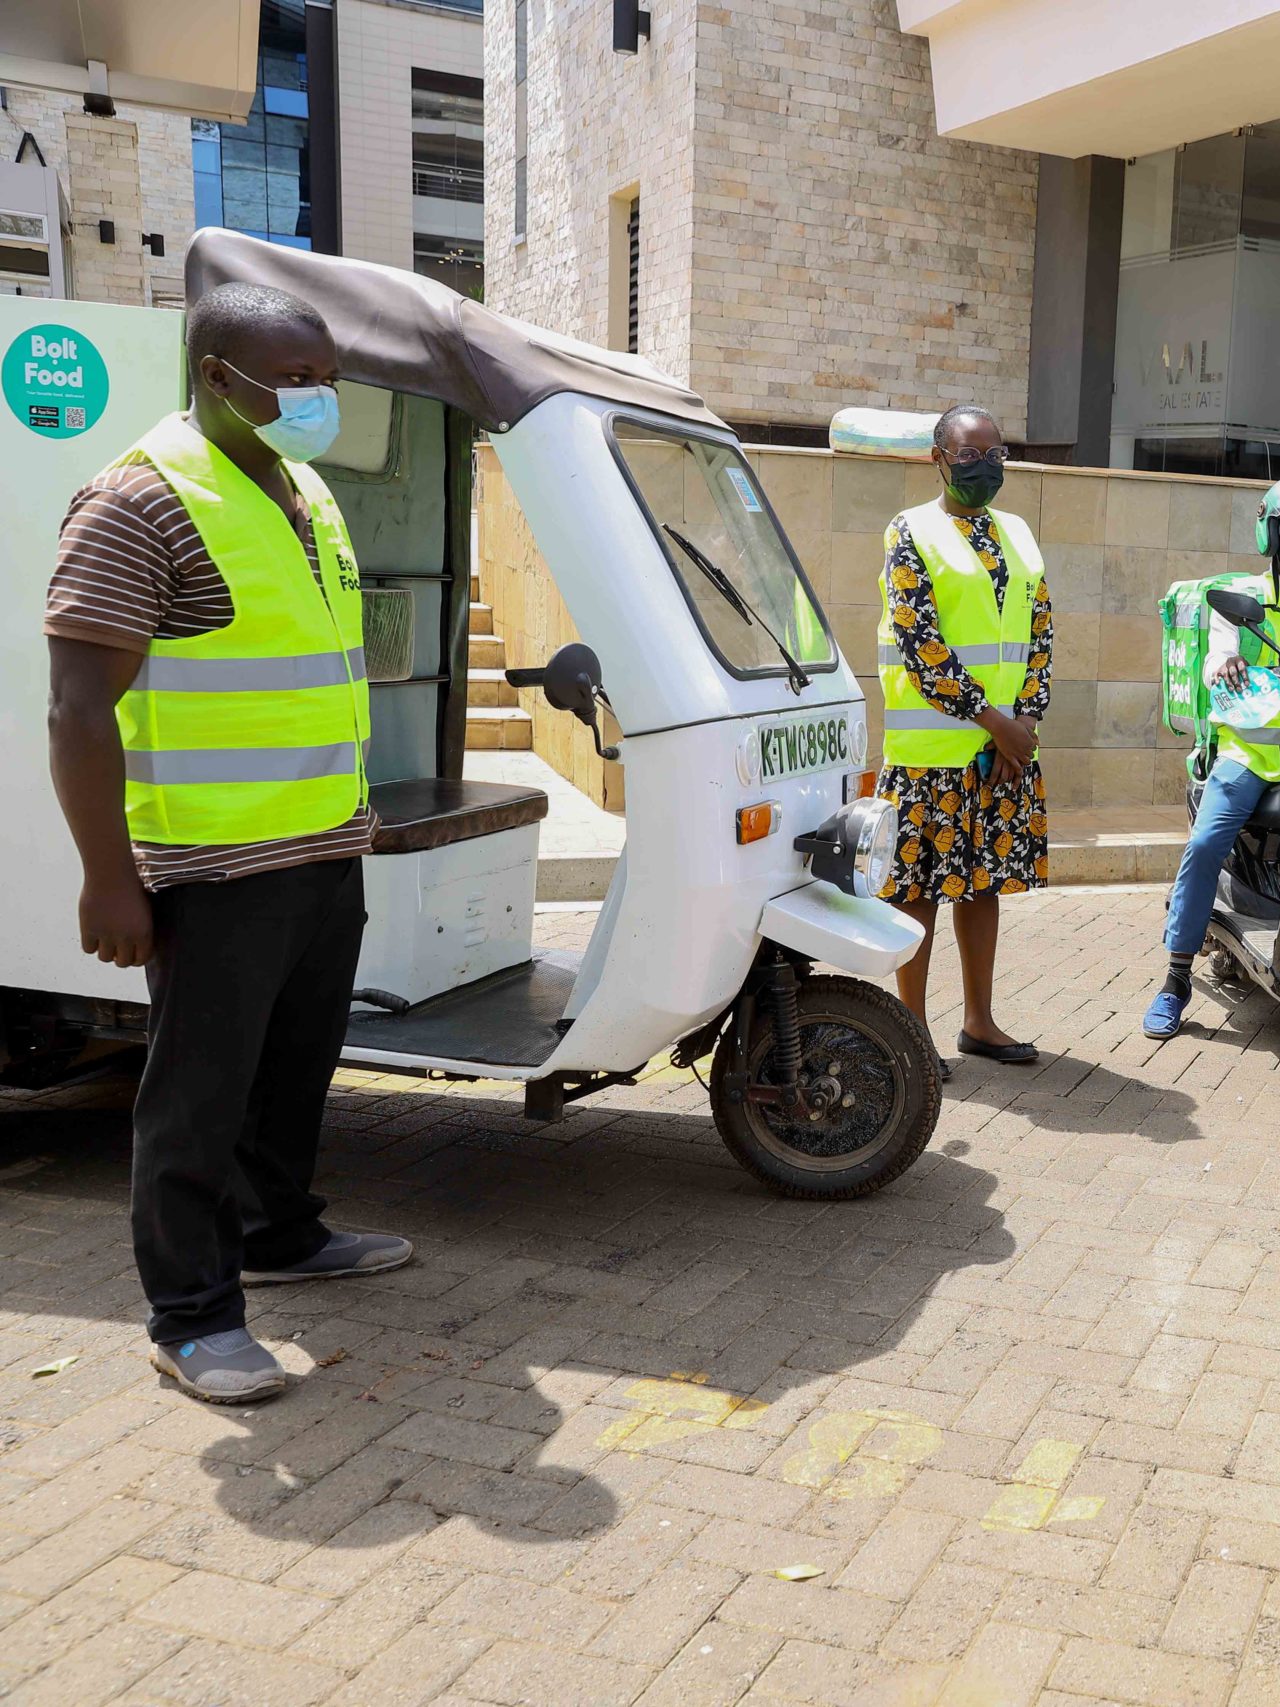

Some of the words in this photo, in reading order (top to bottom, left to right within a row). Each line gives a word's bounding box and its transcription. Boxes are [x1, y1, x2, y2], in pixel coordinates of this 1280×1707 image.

[31, 335, 78, 360] Bolt
[24, 362, 83, 388] Food
[339, 575, 361, 591] Foo
